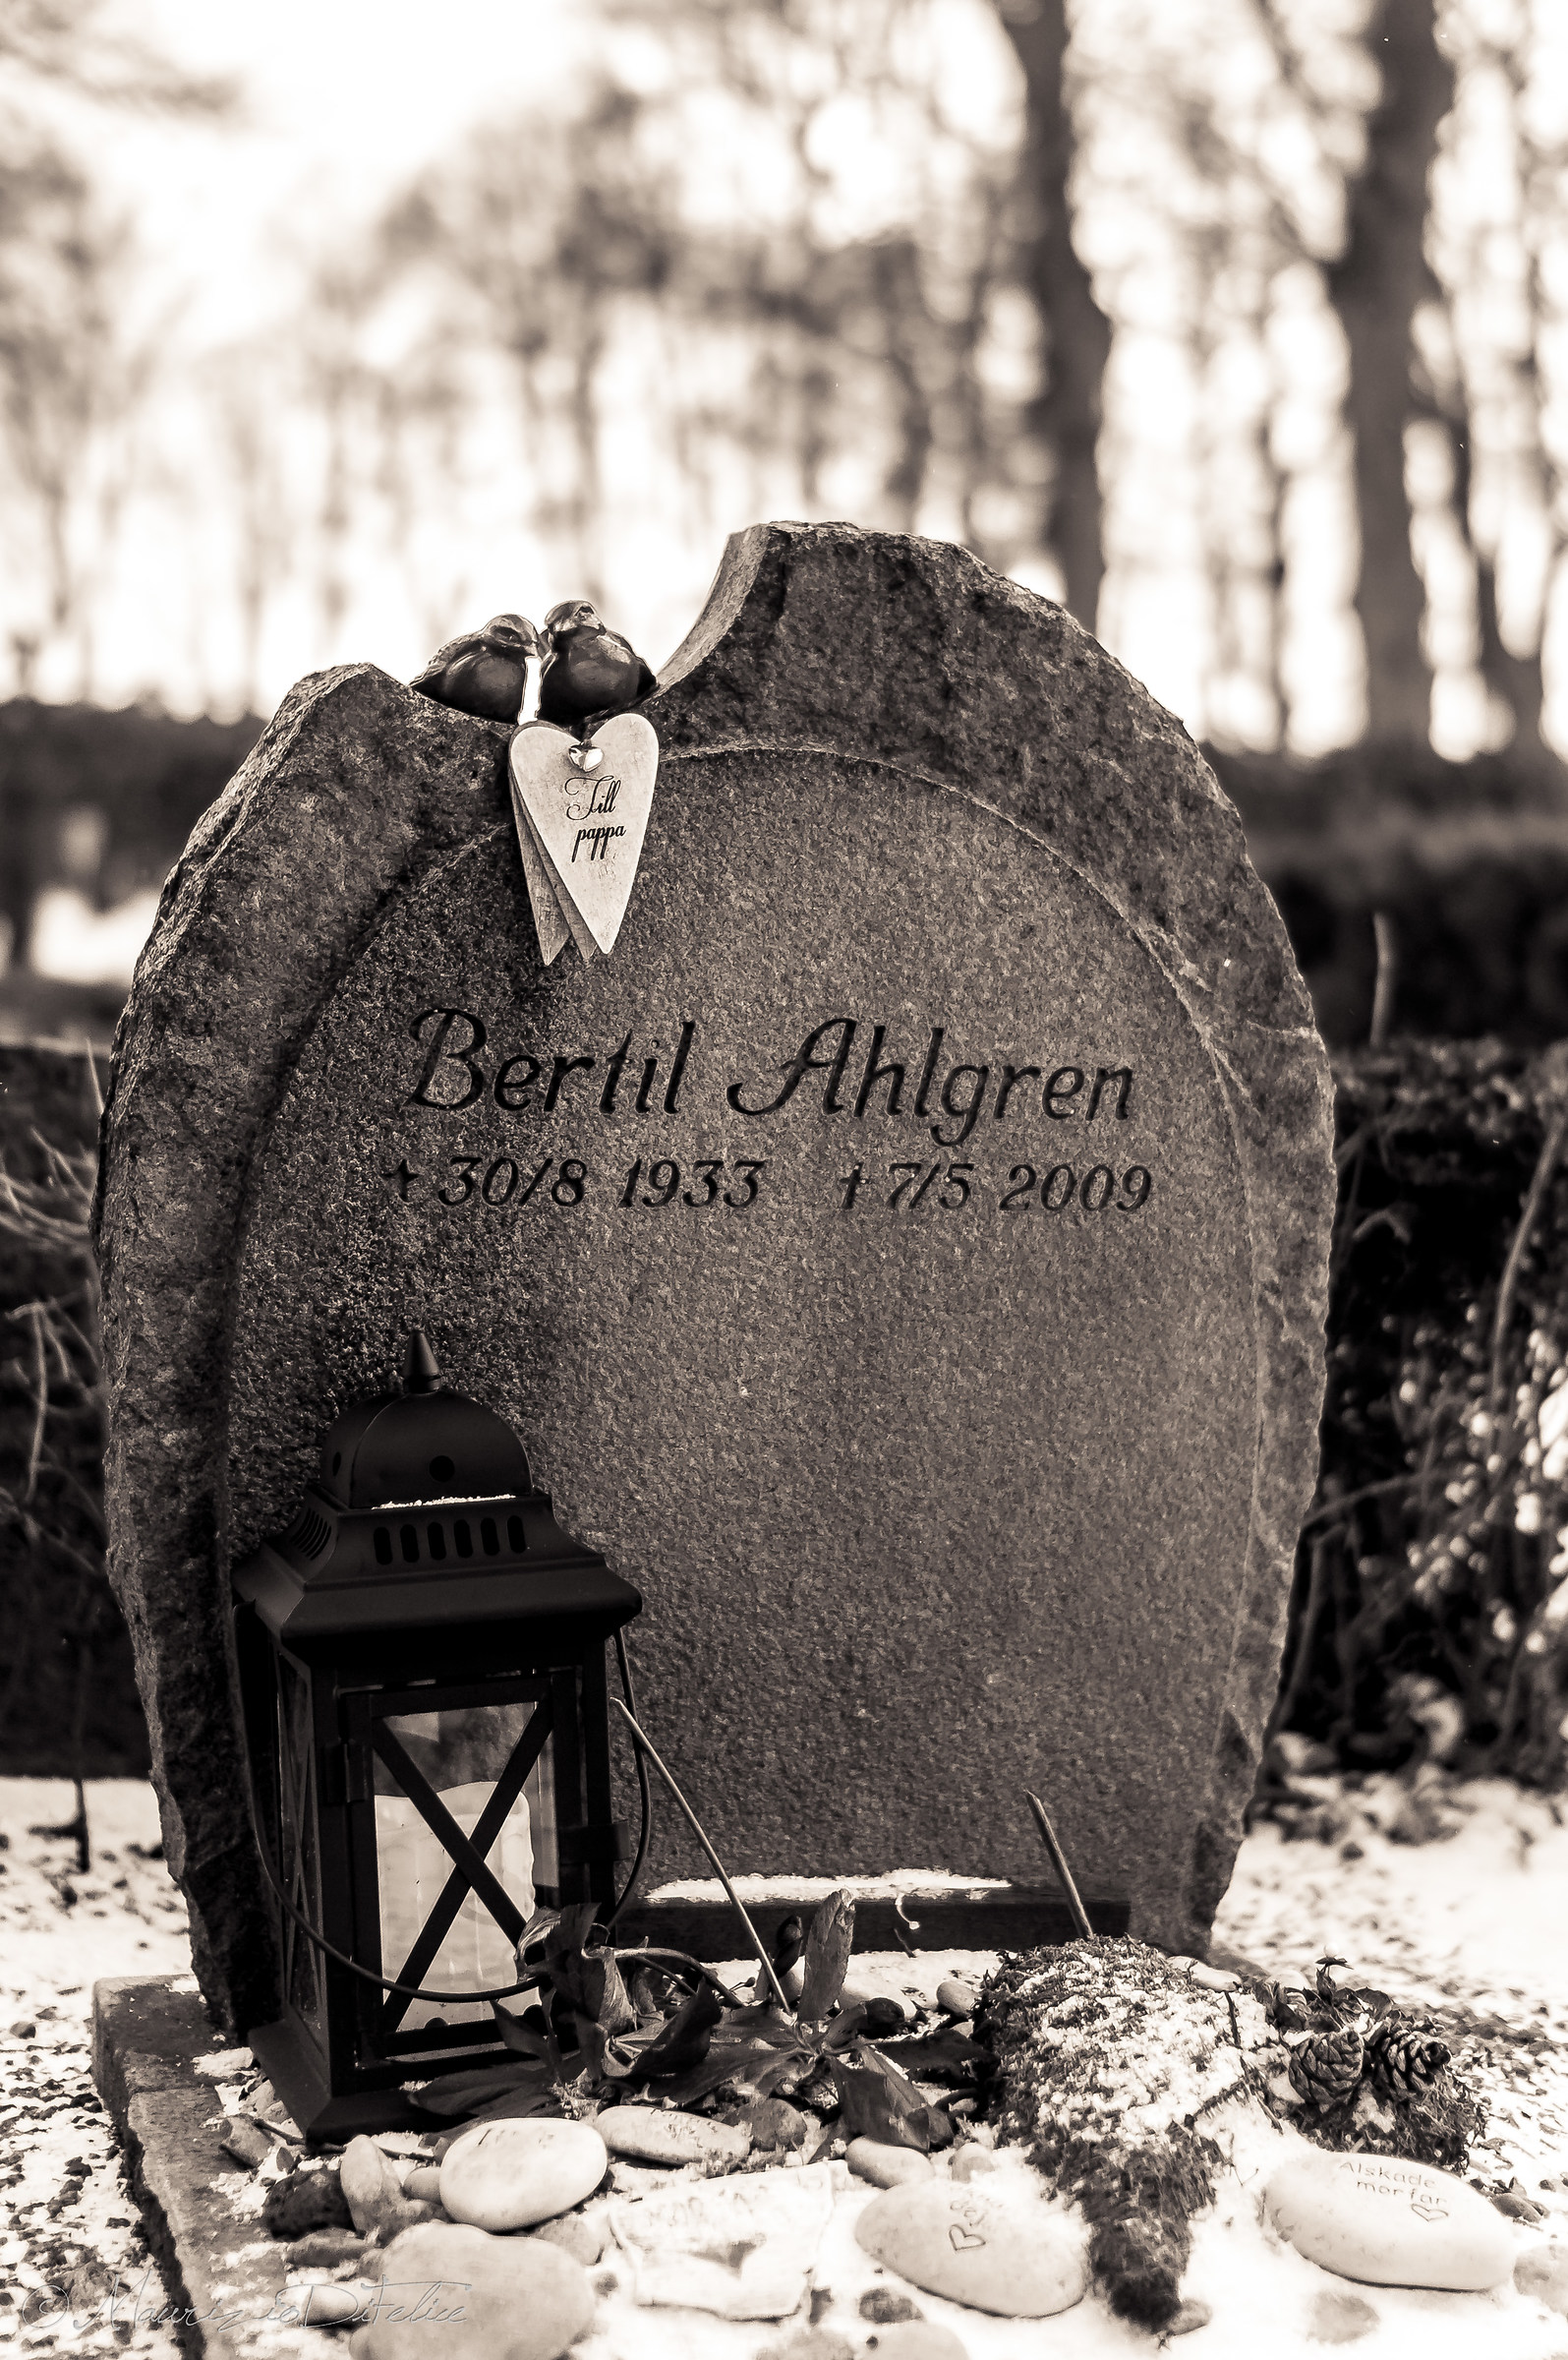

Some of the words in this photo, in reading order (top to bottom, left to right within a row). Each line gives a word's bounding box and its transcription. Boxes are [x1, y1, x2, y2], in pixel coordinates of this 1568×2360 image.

[564, 775, 621, 820] Till
[571, 825, 626, 862] pappa
[408, 1008, 696, 1115] Bertil
[726, 1018, 1134, 1146] Ahlgren
[619, 1159, 766, 1209] 1933
[999, 1164, 1153, 1211] 2009
